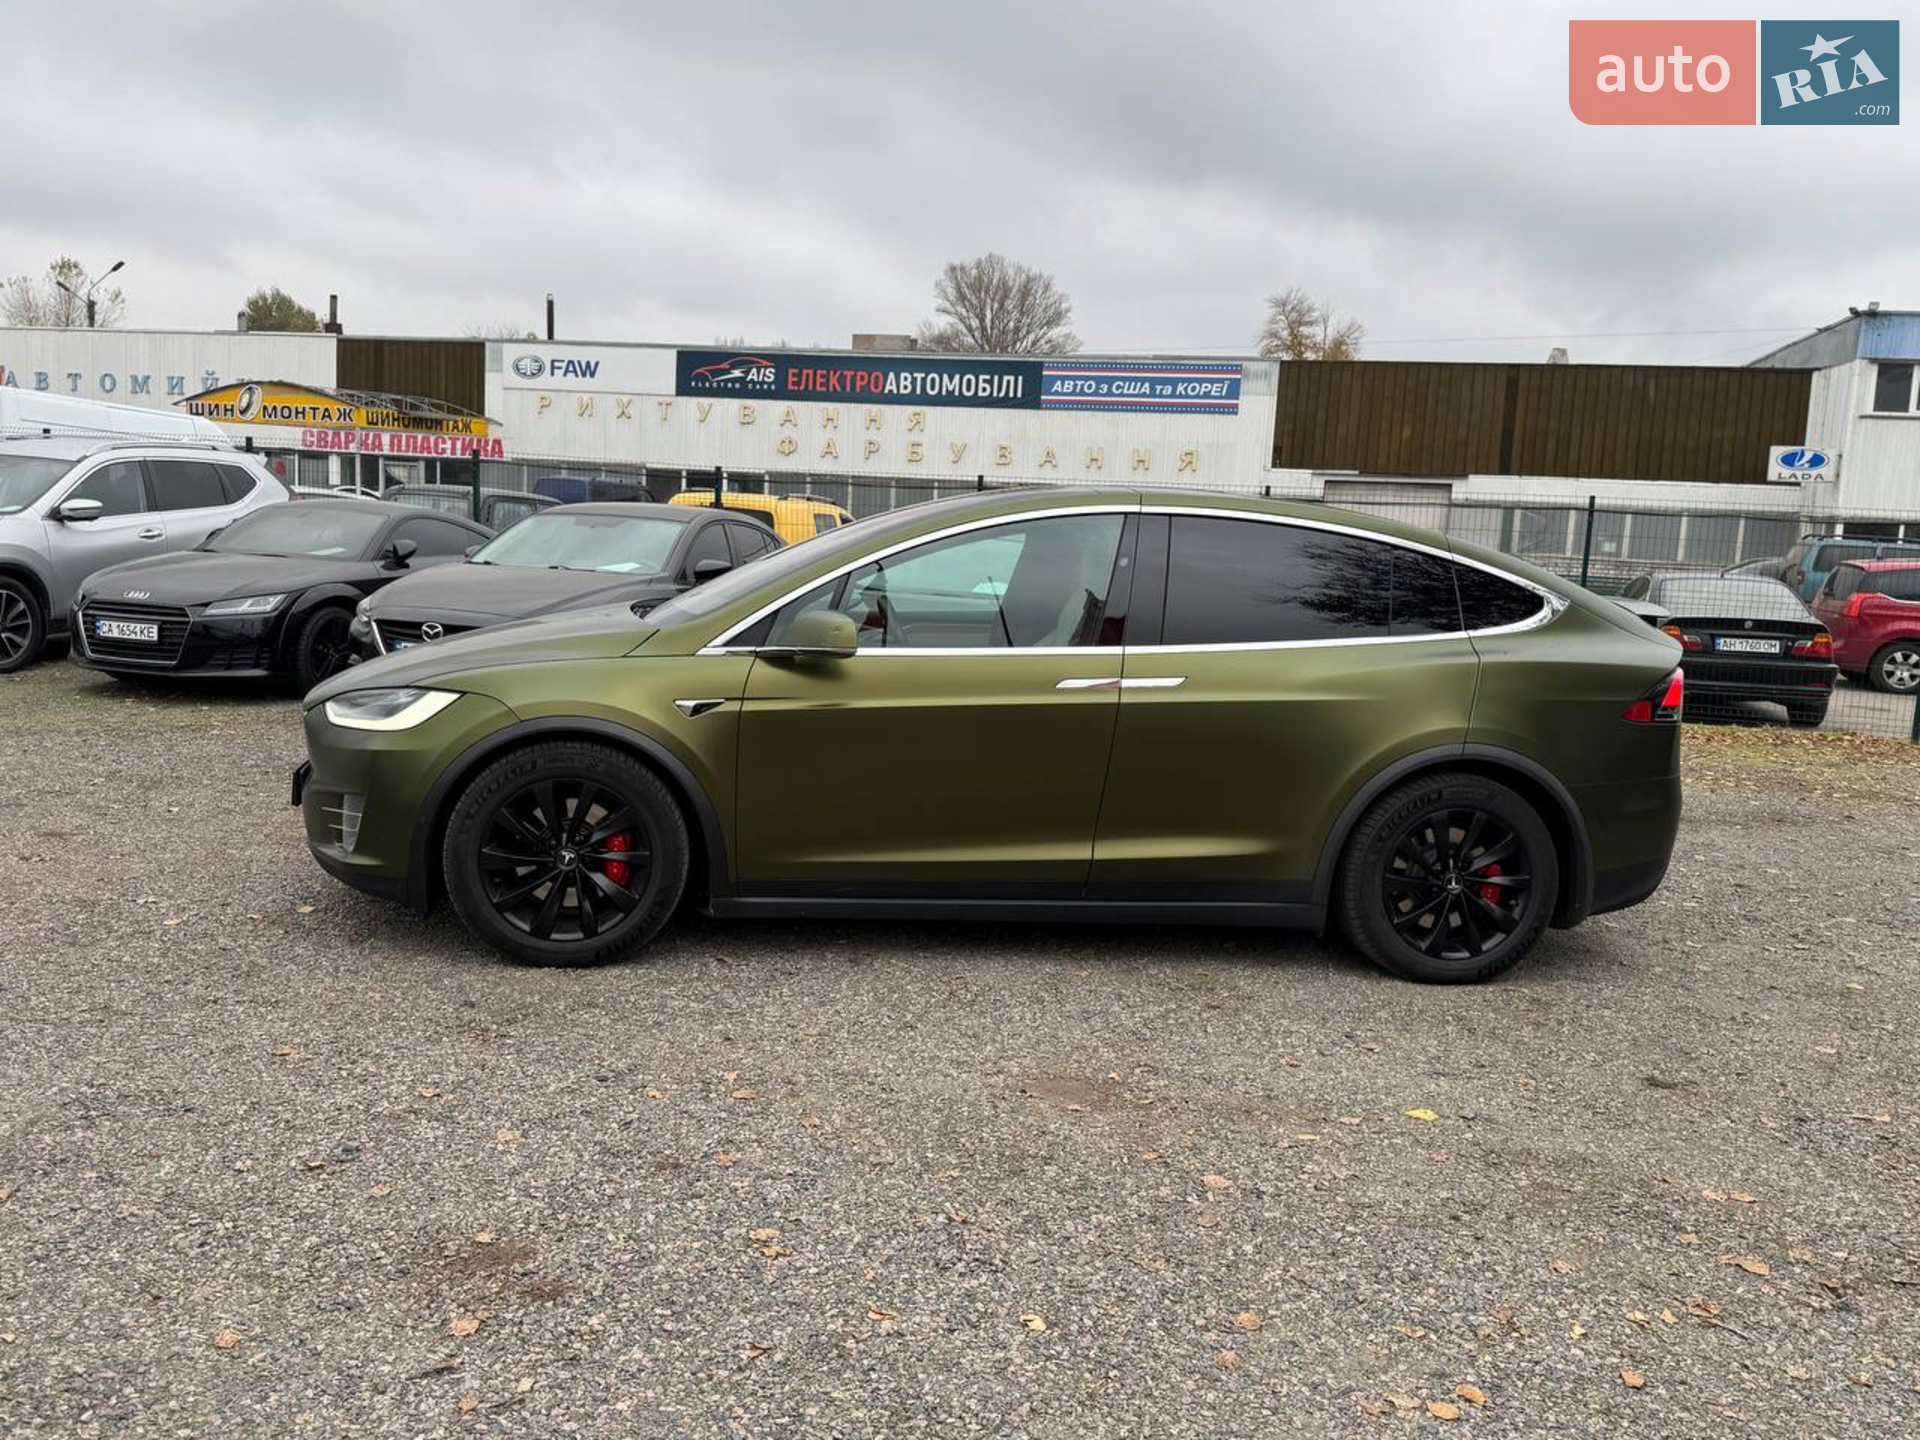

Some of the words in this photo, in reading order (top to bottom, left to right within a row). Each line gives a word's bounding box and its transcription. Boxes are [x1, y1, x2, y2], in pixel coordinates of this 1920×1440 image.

[550, 359, 600, 378] FAW
[745, 367, 776, 383] AIS
[4, 370, 253, 395] АВТОМИЙ
[787, 368, 1023, 399] ЕЛЕКТРОАВТОМОБІЛІ
[1051, 380, 1096, 394] АВТО
[1112, 381, 1150, 395] США
[1155, 385, 1172, 395] та
[1176, 381, 1231, 397] КОРЕЇ
[366, 409, 474, 434] ШИНОМОНТАЖ
[302, 428, 384, 453] СВАРКА
[389, 433, 505, 459] ПЛАСТИКА
[777, 436, 1199, 472] ФАРБУВАННЯ
[1777, 472, 1824, 481] LADA
